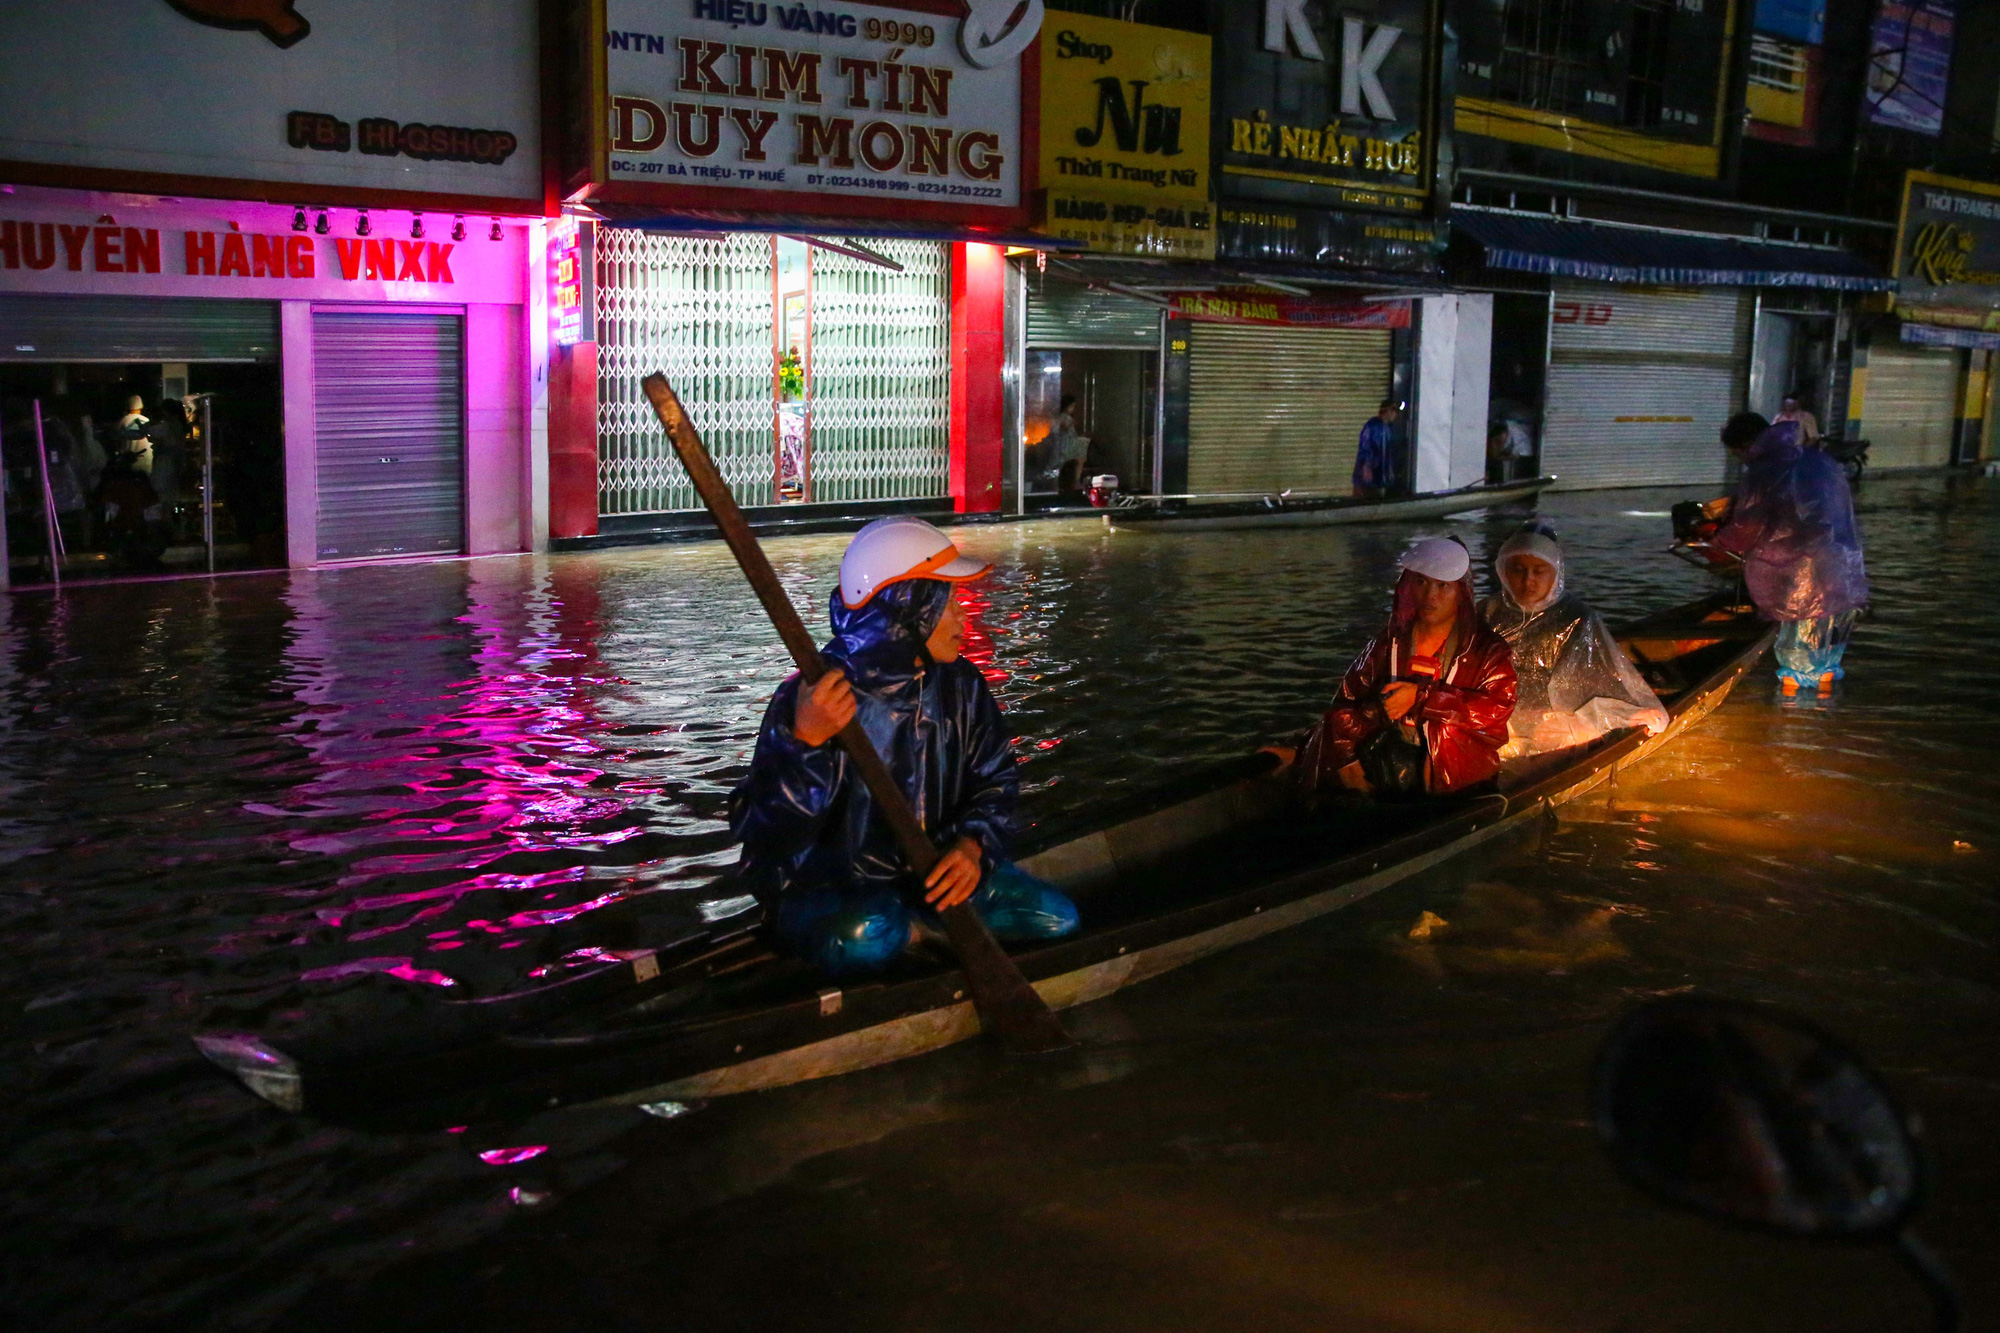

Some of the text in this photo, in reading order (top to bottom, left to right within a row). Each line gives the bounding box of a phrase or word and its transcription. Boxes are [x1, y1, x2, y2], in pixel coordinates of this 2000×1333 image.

[777, 2, 857, 37] VÀNG
[866, 17, 935, 47] 9999
[1057, 30, 1112, 64] Shop
[678, 37, 953, 118] KIM TÍN
[1339, 16, 1402, 121] K
[611, 96, 1004, 182] DUY MONG
[1232, 109, 1421, 175] RẺ NHẤT HUẾ
[640, 162, 664, 174] 207
[668, 162, 687, 176] BÀ
[758, 168, 786, 182] HUẾ
[1107, 162, 1166, 188] Trang
[1055, 196, 1107, 221] HÀNG
[186, 221, 315, 279] HÀNG
[336, 238, 456, 284] VNXK
[1913, 222, 1967, 286] King
